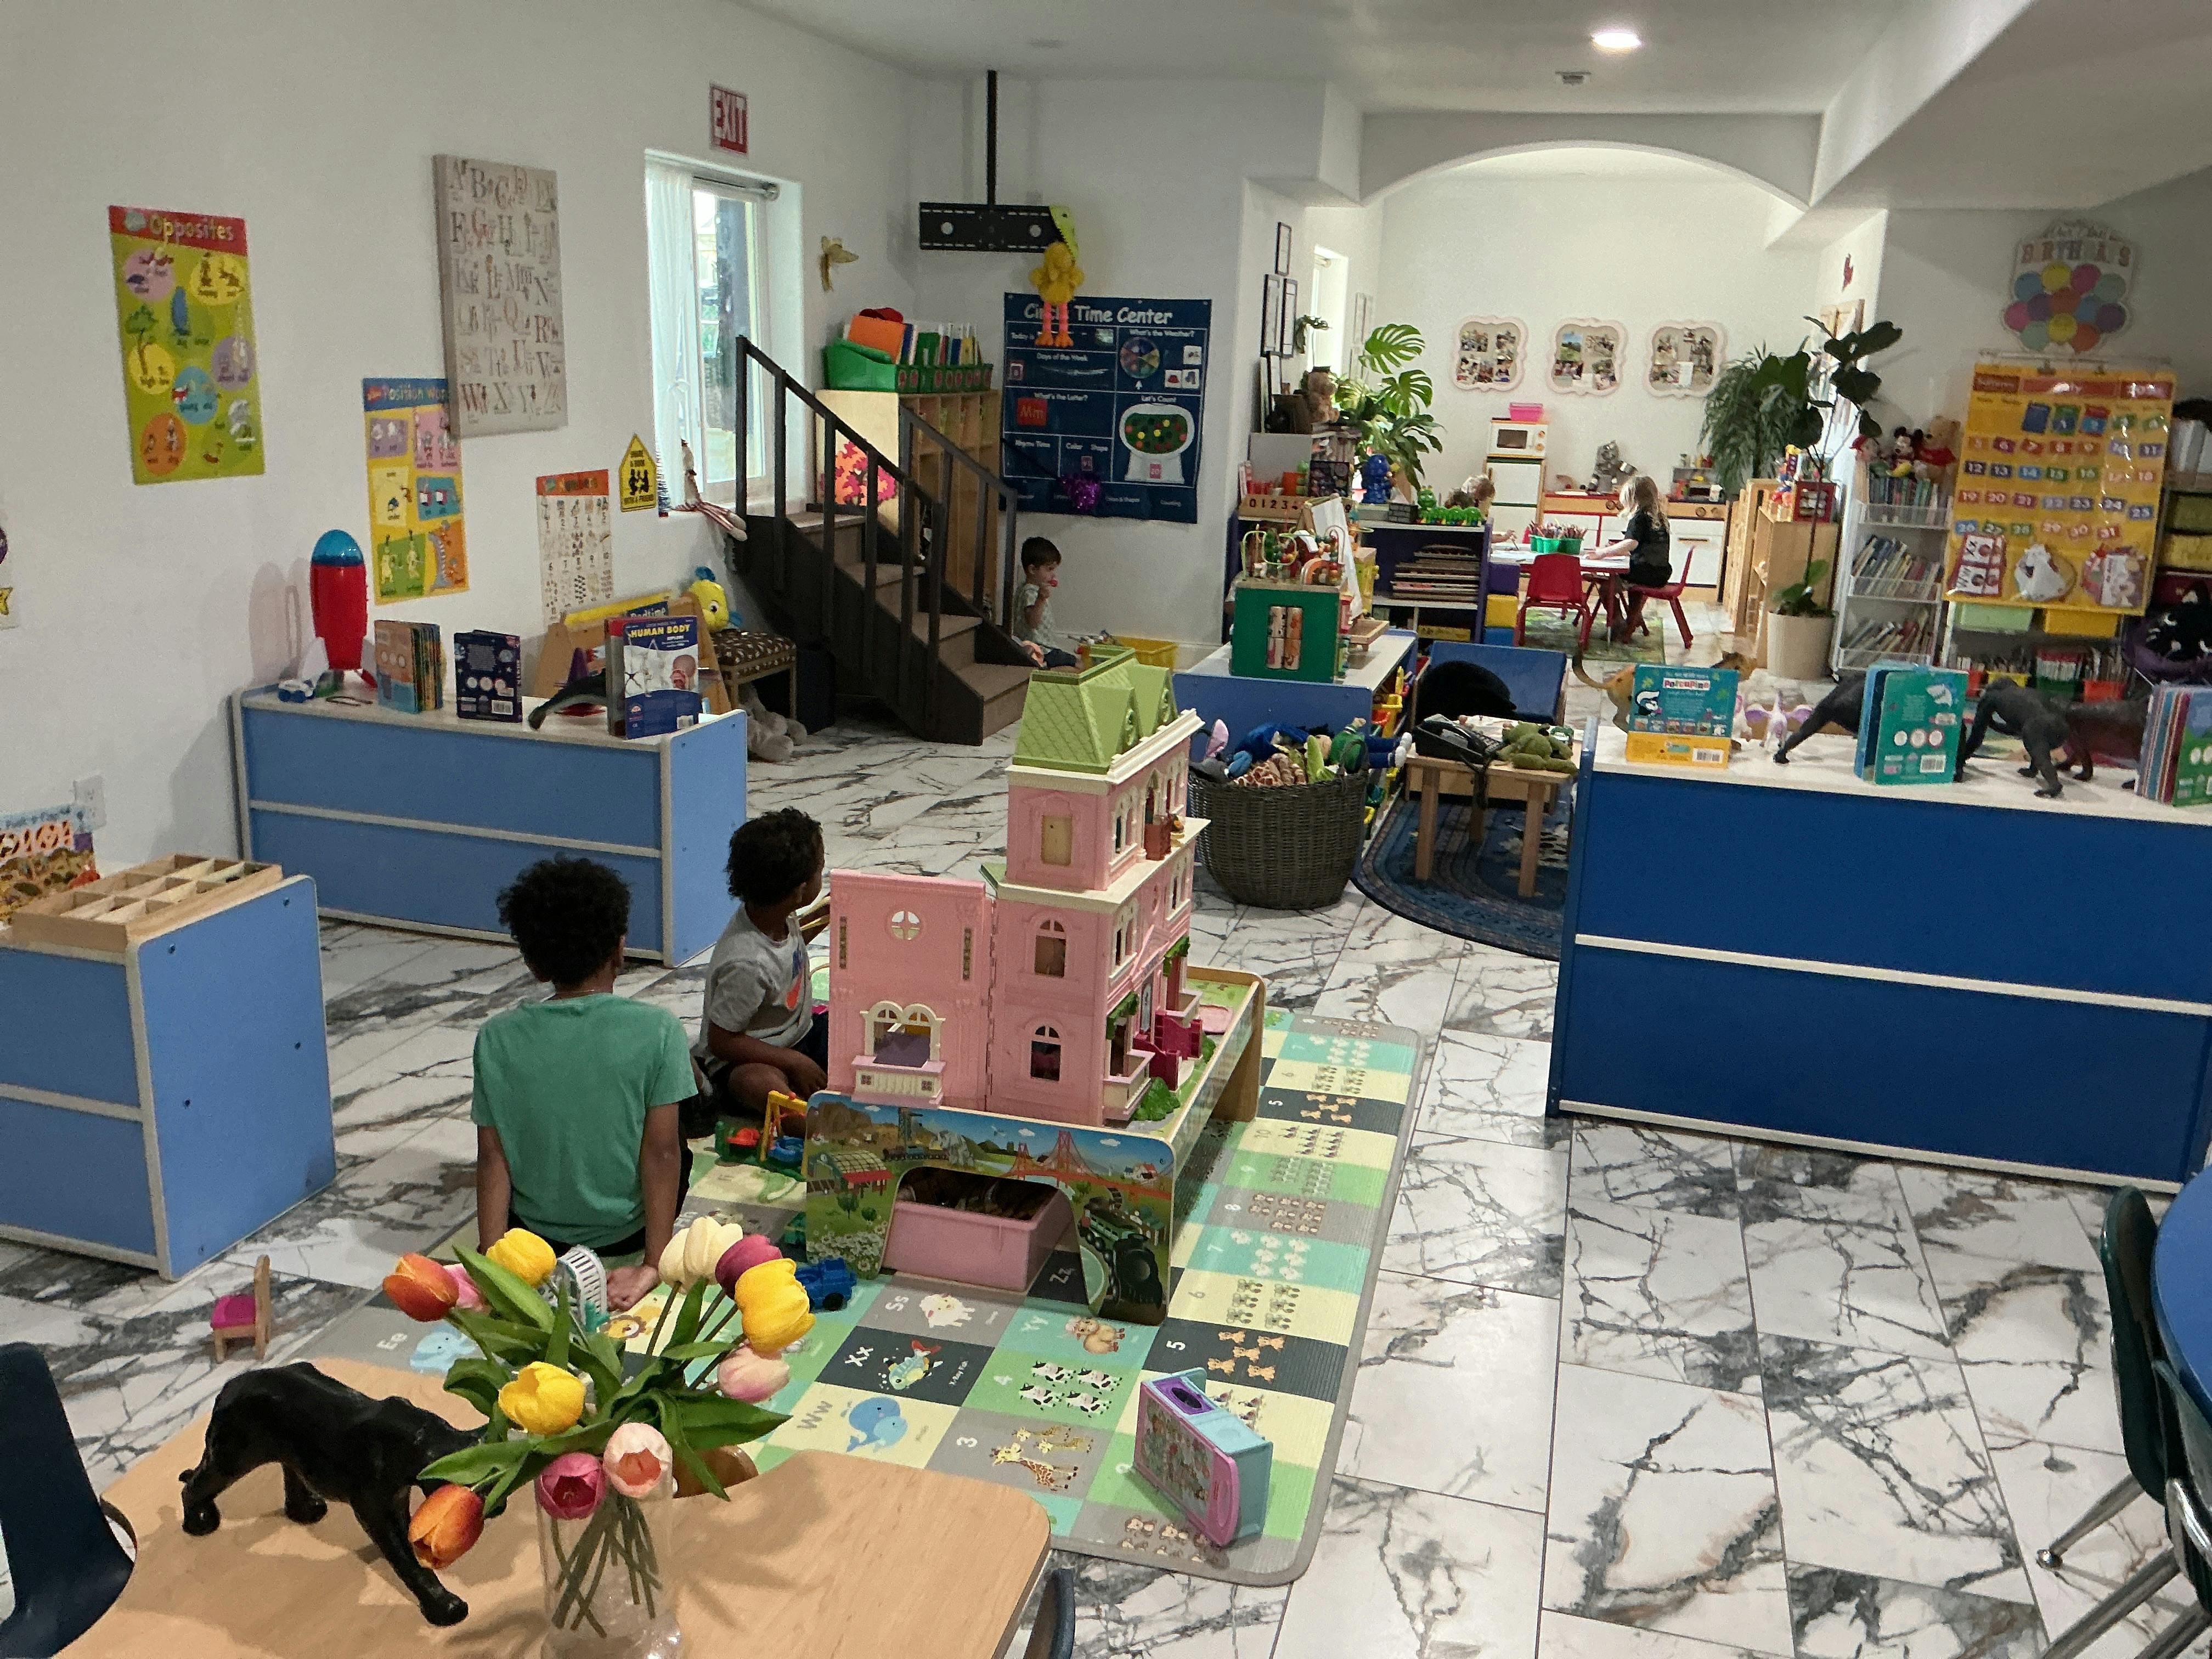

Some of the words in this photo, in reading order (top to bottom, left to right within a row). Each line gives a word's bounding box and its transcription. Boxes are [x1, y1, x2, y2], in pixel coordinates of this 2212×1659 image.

[713, 88, 747, 145] EXIT
[150, 214, 234, 245] Opposites
[1074, 305, 1113, 323] Time
[1116, 307, 1173, 325] Center
[1250, 499, 1256, 507] 0
[1270, 500, 1277, 509] 2
[1281, 500, 1288, 509] 3
[630, 627, 664, 638] HUMAN
[667, 624, 690, 634] BODY
[1664, 680, 1709, 690] Porcupine
[1224, 1203, 1242, 1211] 8
[1207, 1244, 1224, 1253] 7
[1048, 1267, 1076, 1284] Zz
[885, 1295, 909, 1312] Ss
[376, 1333, 408, 1350] Ee
[1166, 1340, 1186, 1351] 5
[845, 1346, 874, 1367] Xx
[993, 1374, 1013, 1386] 4
[797, 1400, 833, 1430] Ww
[956, 1436, 978, 1448] 3
